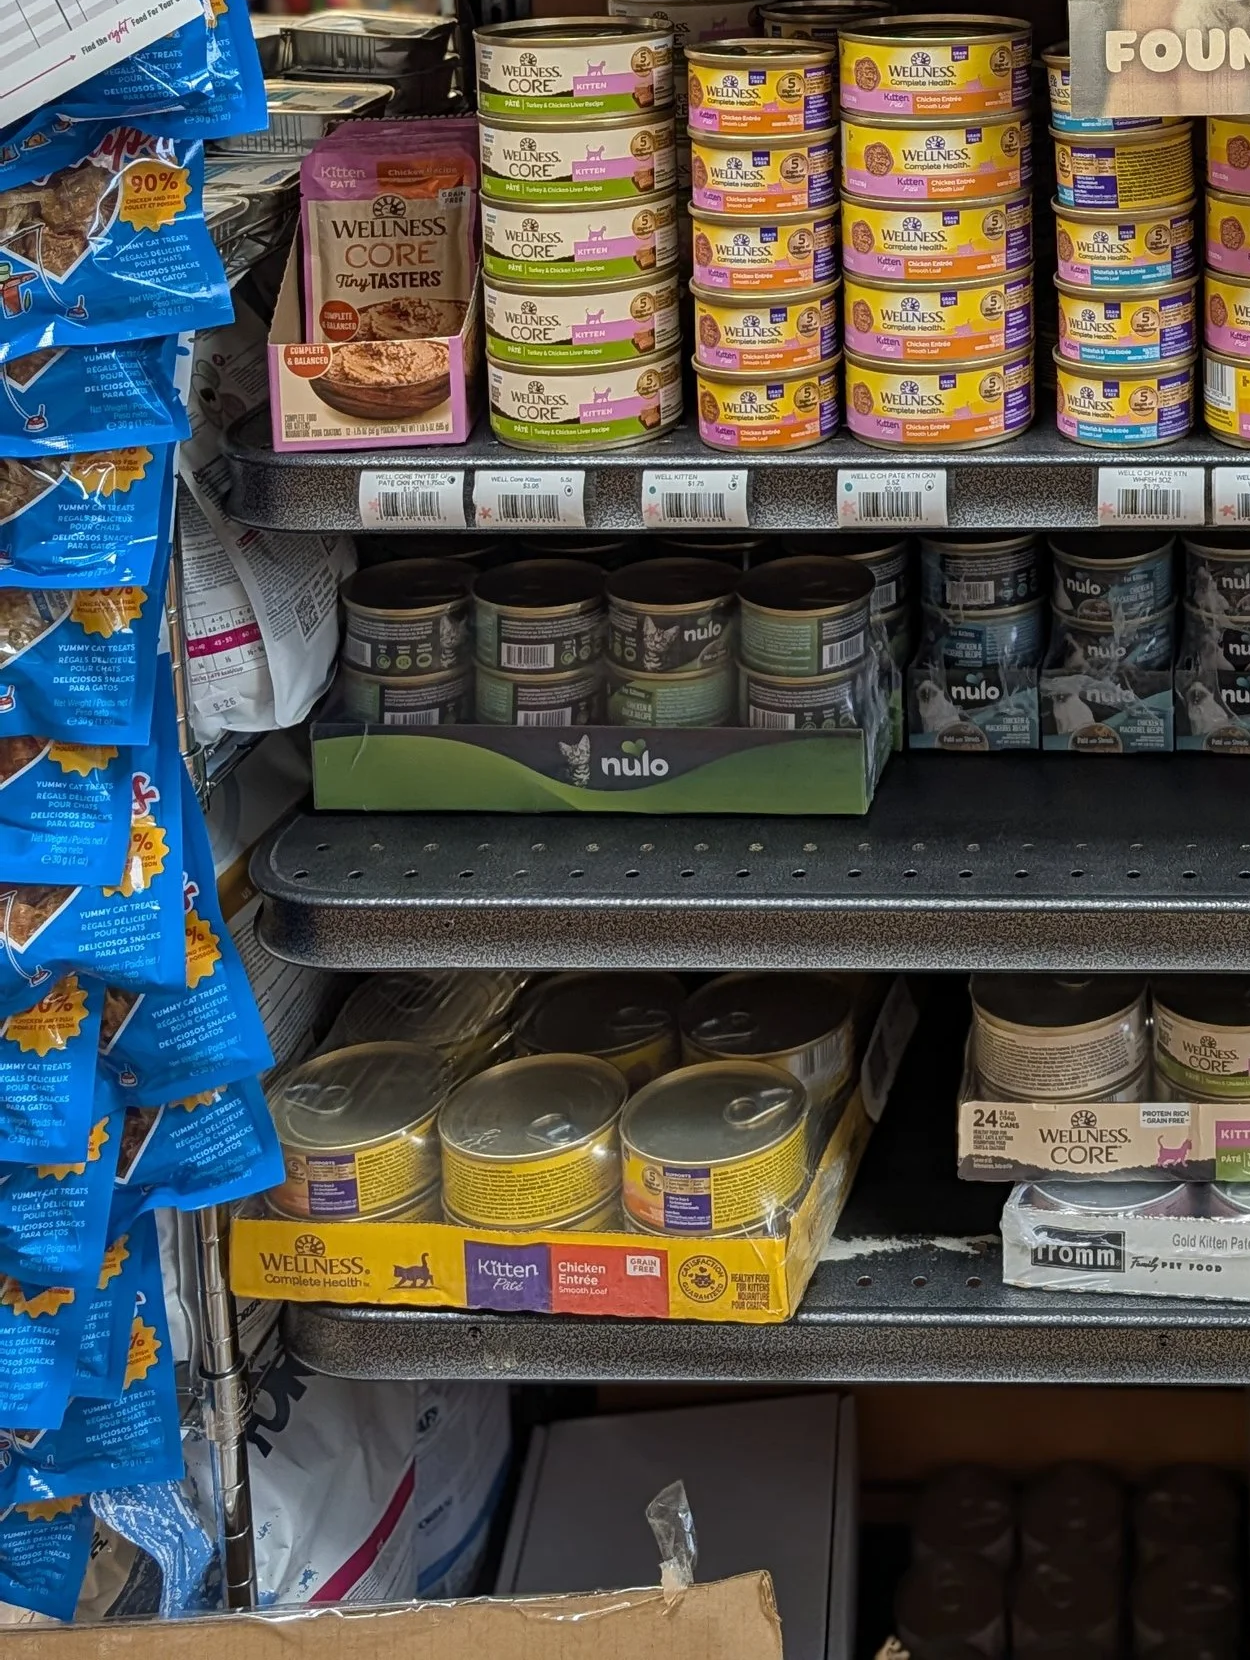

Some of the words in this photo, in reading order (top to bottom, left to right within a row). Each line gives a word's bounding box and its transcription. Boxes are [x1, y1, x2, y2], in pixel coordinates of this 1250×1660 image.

[81, 44, 96, 55] Find
[97, 38, 108, 46] the
[108, 17, 132, 43] right
[131, 15, 147, 27] Food
[148, 8, 159, 17] For
[158, 0, 174, 11] Your
[321, 167, 366, 179] Kitten
[131, 172, 178, 193] 90%
[332, 217, 446, 238] WELLNESS
[345, 241, 437, 268] CORE
[290, 346, 324, 355] COMPLETE
[295, 356, 328, 365] BALANCED
[929, 423, 950, 431] Entrée
[602, 749, 669, 777] nulo
[973, 1109, 999, 1127] 24
[1040, 1128, 1130, 1143] WELLNESS
[1050, 1145, 1119, 1164] CORE
[1173, 1233, 1196, 1248] Gold
[1199, 1234, 1228, 1250] Kitten
[259, 1252, 365, 1275] WELLNESS
[478, 1258, 539, 1280] Kitten
[558, 1261, 606, 1274] Chicken
[630, 1257, 657, 1267] GRAIN
[632, 1265, 655, 1273] FREE
[1161, 1261, 1183, 1270] PET
[1189, 1263, 1222, 1272] FOOD
[264, 1274, 321, 1287] Complete
[323, 1278, 362, 1288] Health
[558, 1274, 599, 1285] Entrée
